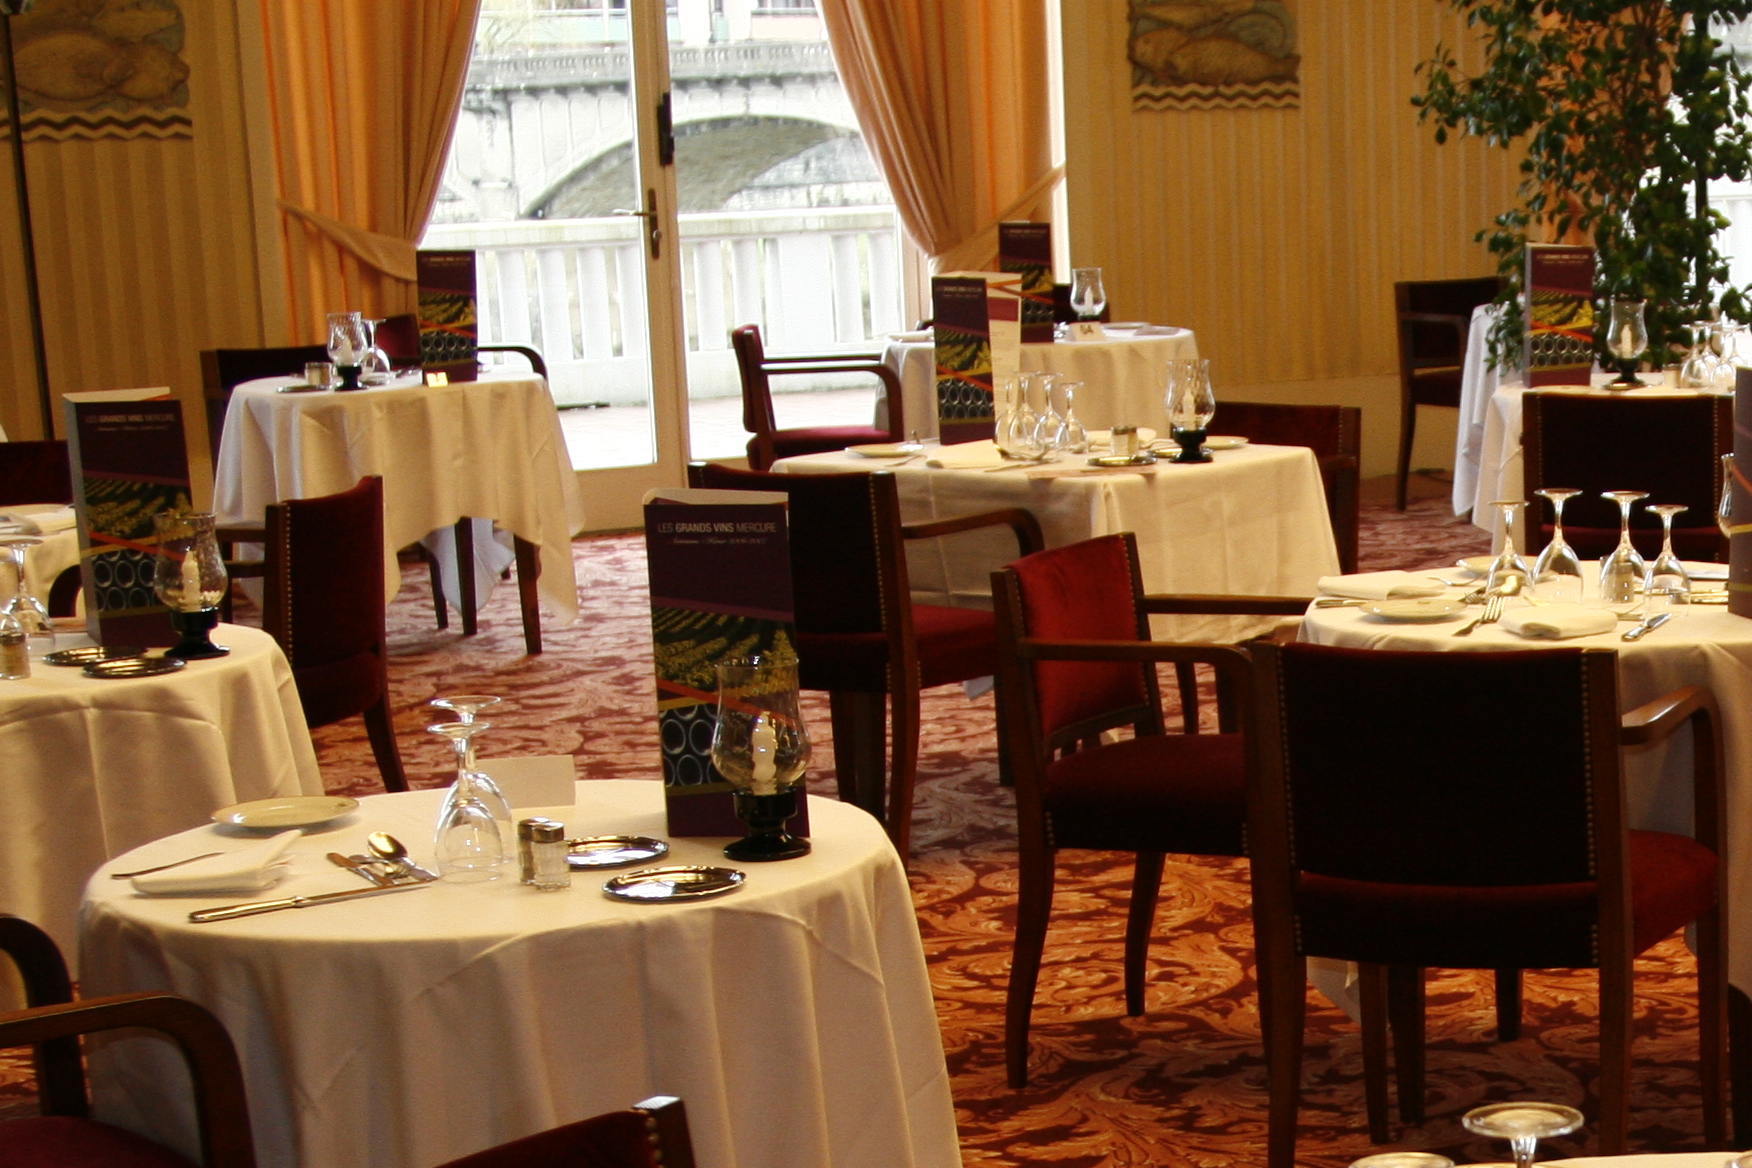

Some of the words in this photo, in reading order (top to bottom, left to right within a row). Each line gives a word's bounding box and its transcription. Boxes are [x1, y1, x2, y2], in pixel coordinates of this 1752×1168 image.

[657, 522, 673, 533] LES
[675, 522, 713, 533] GRANDS
[713, 522, 734, 533] VINS
[736, 522, 777, 533] MERCURE
